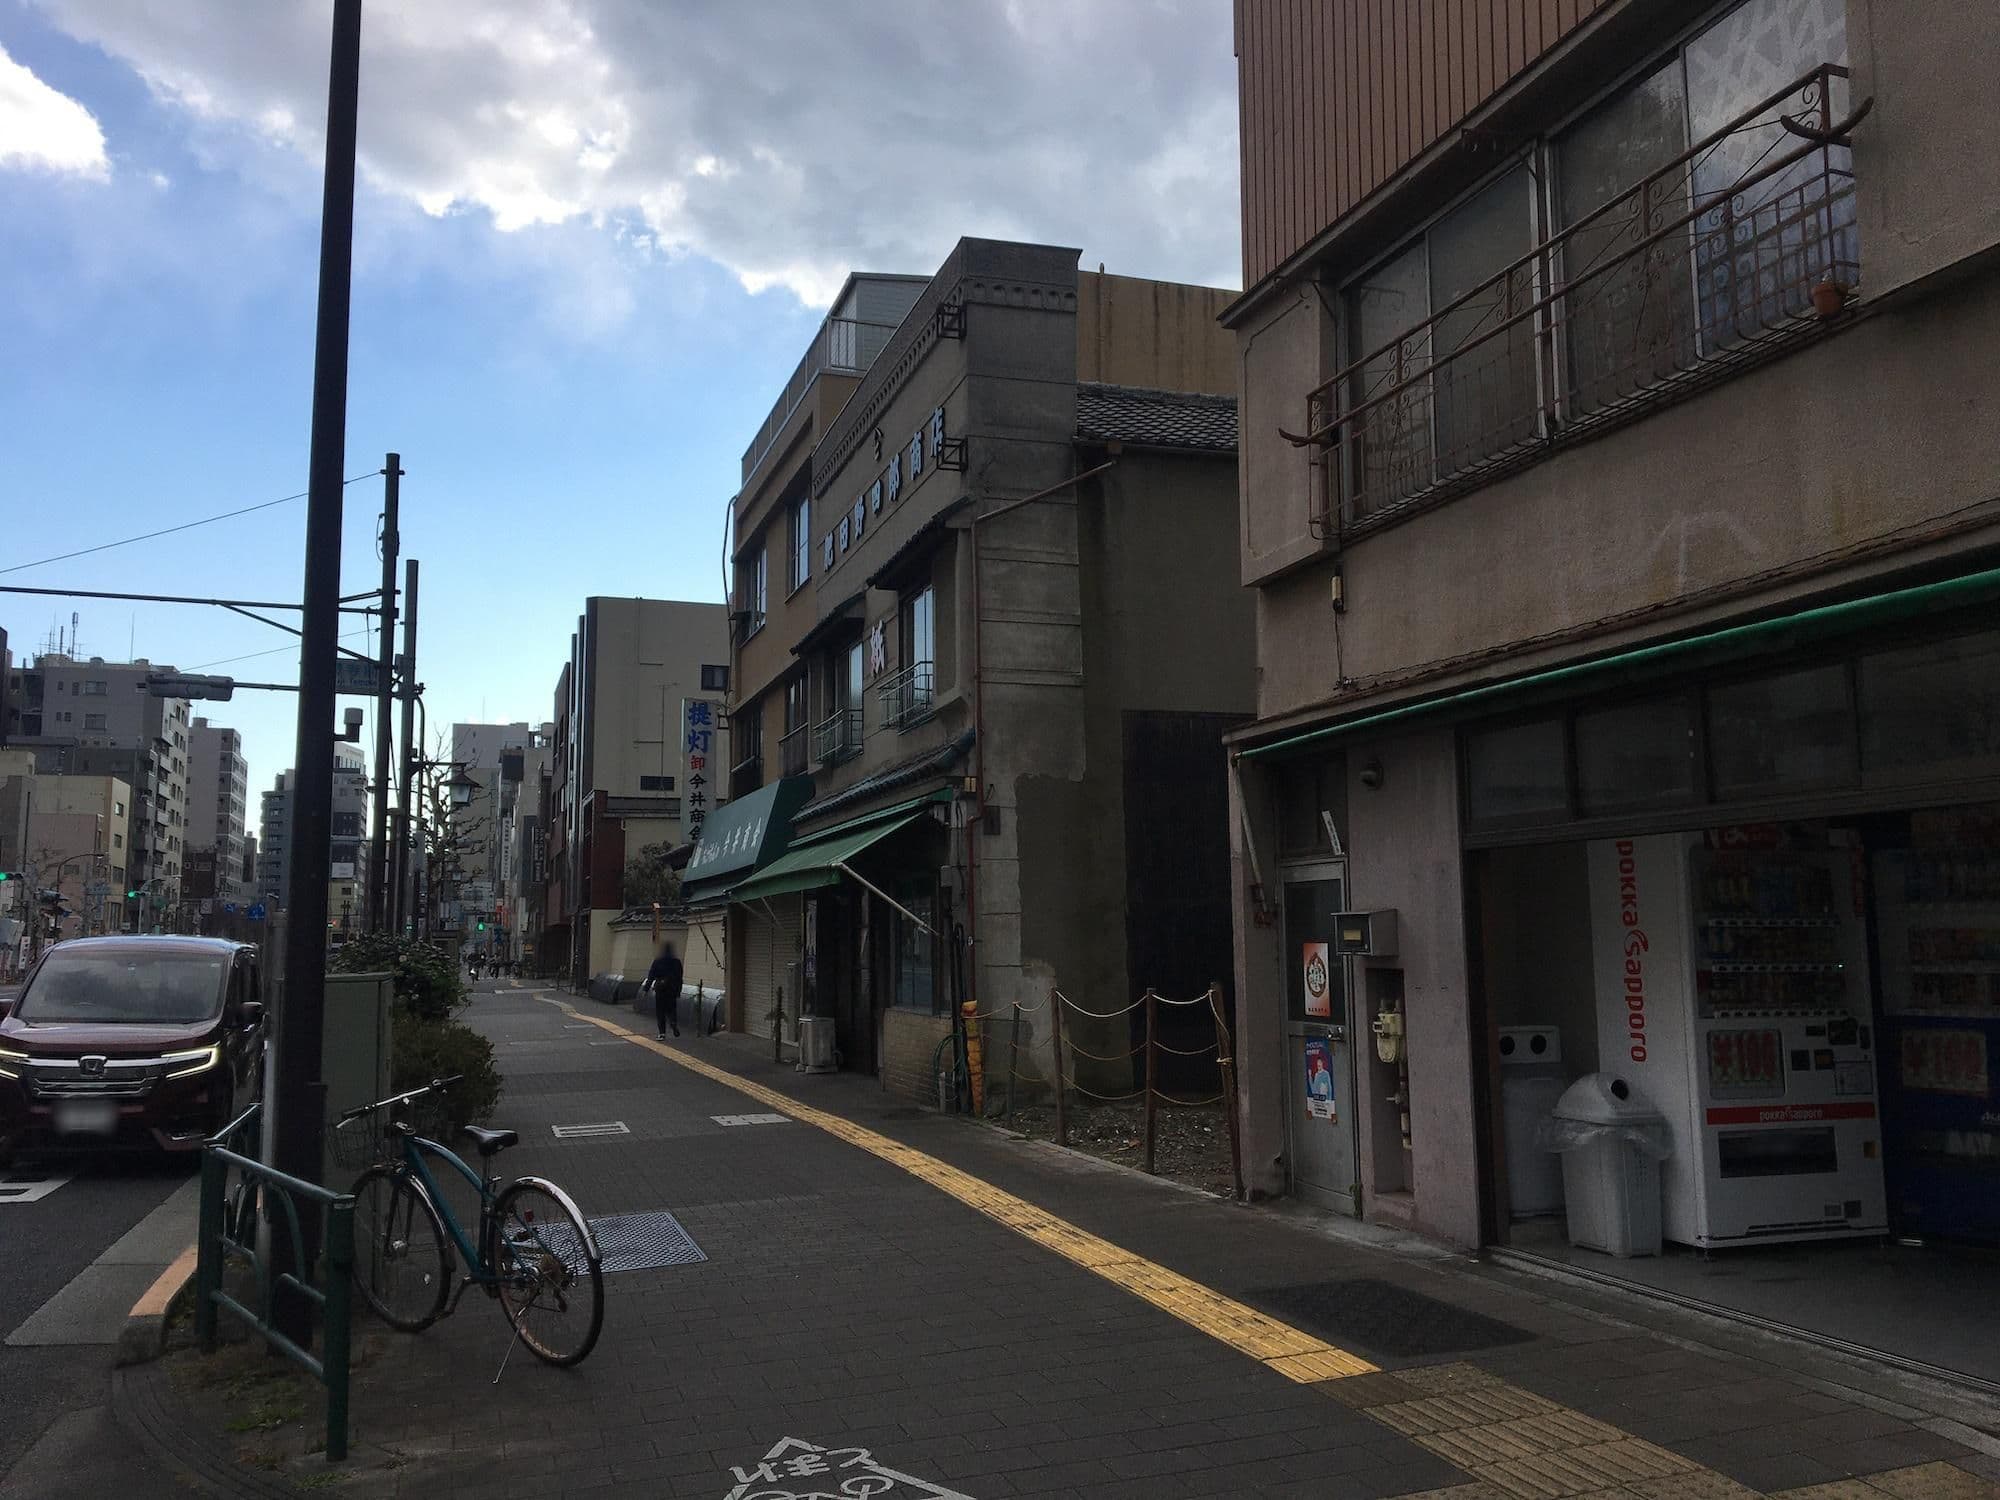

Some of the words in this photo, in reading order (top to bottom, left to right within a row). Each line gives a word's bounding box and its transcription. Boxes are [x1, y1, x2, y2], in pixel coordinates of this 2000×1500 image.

[688, 702, 712, 753] 提灯
[690, 755, 705, 770] 卸
[1623, 930, 1648, 1062] sapporo
